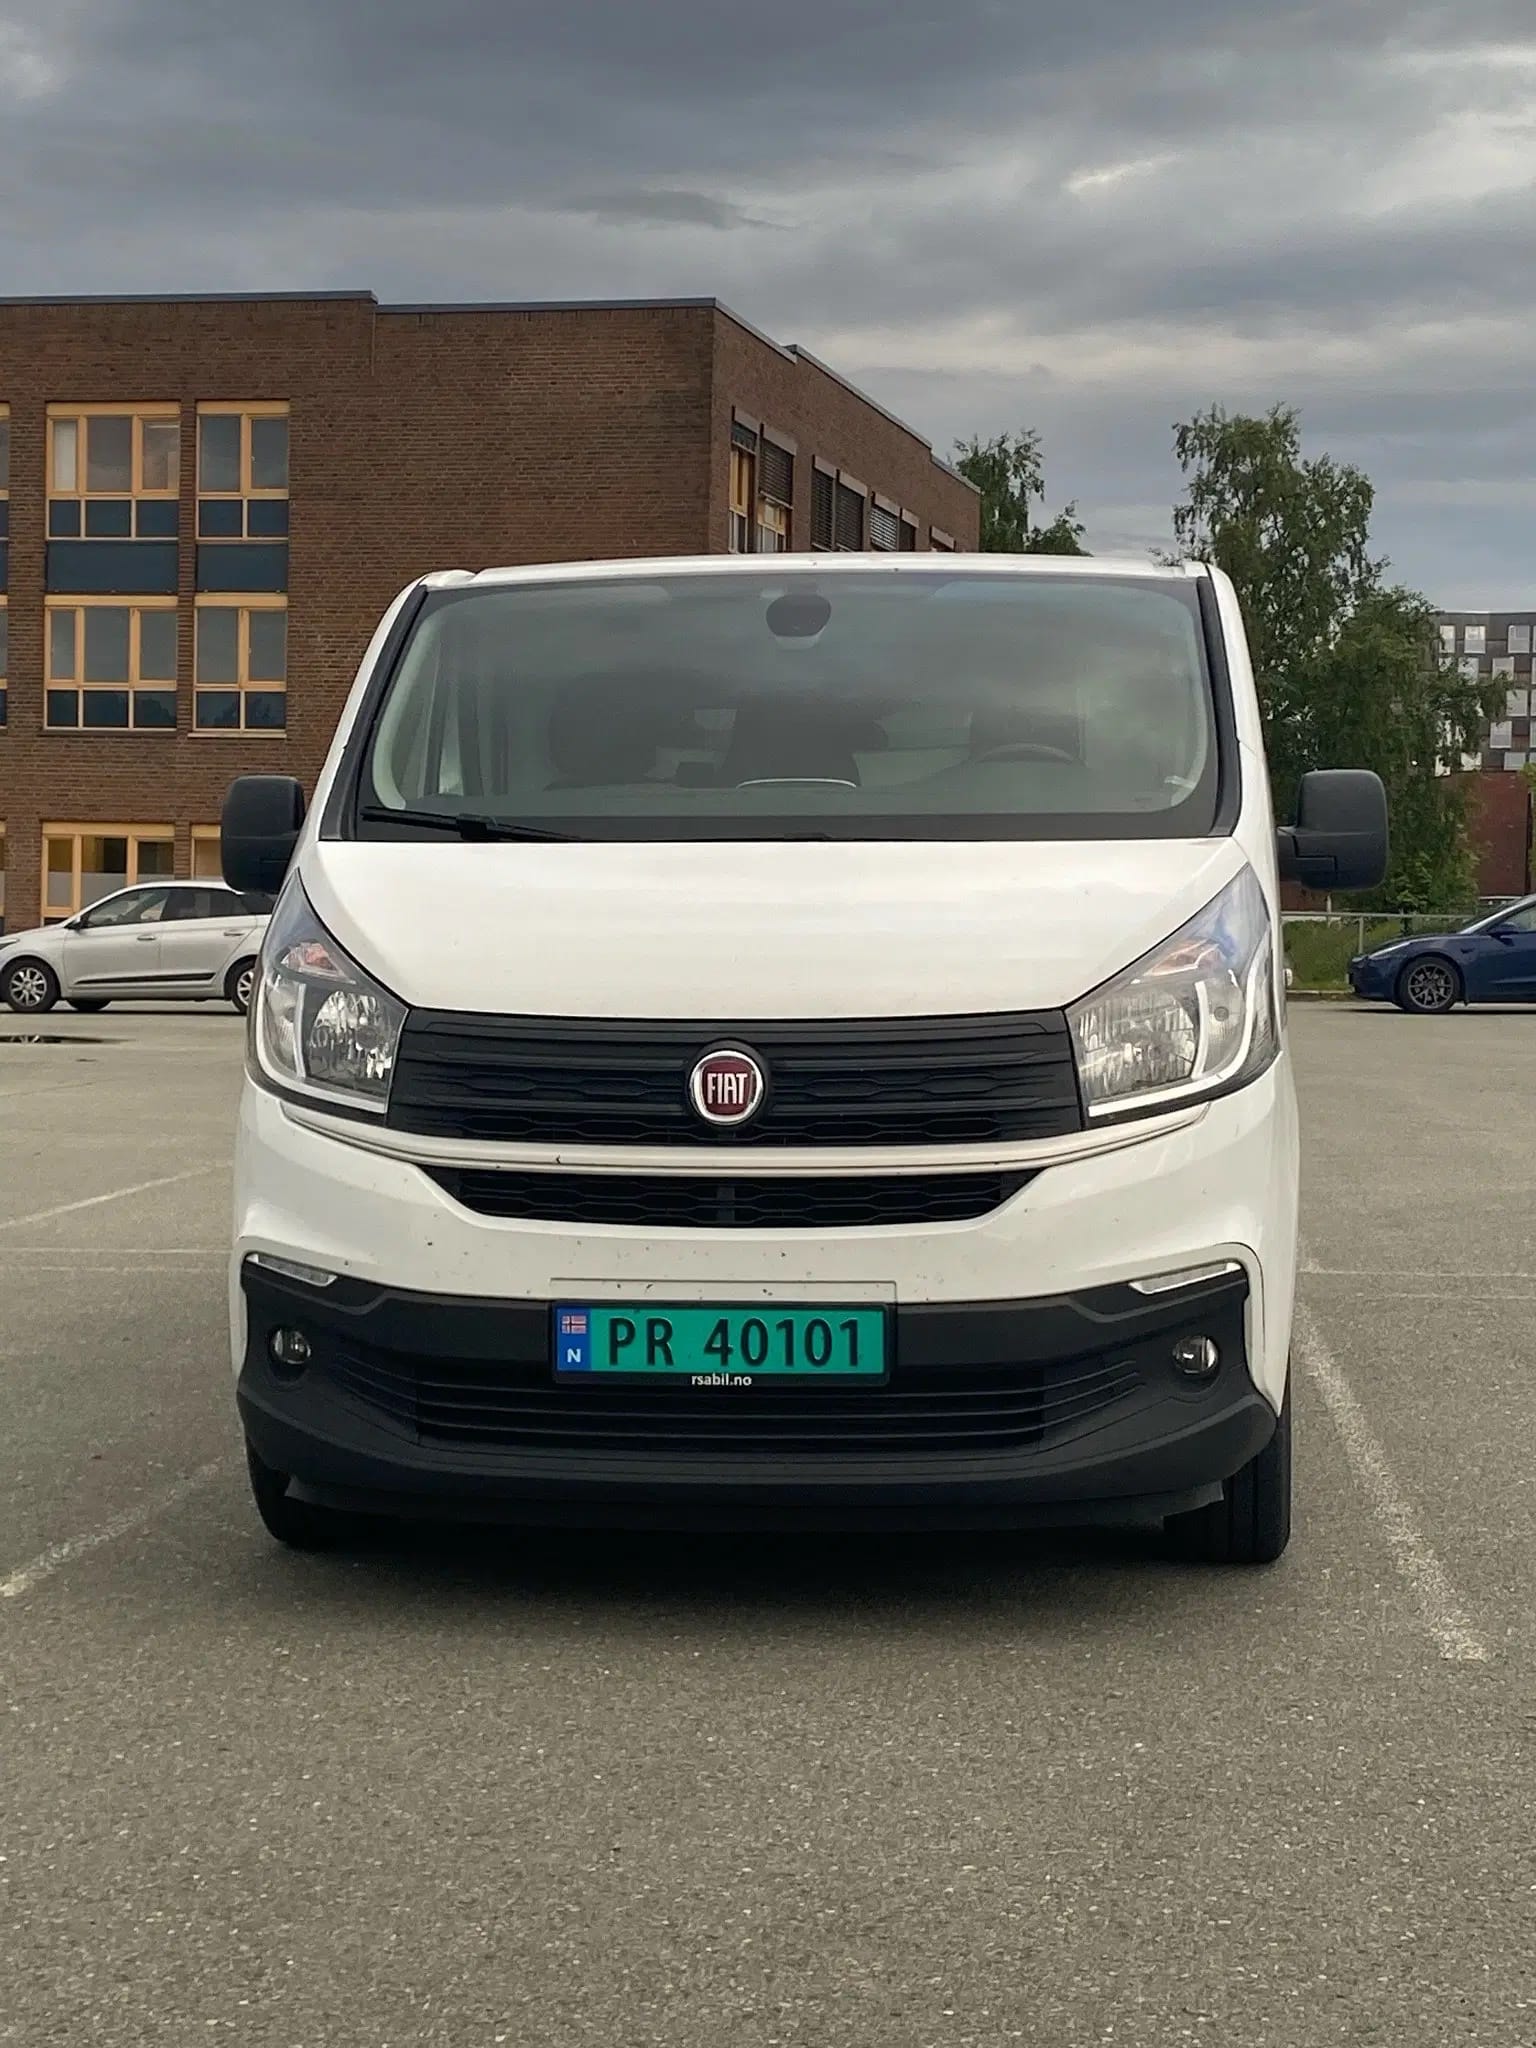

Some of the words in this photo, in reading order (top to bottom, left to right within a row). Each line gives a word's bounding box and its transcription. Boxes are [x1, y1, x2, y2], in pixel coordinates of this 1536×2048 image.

[707, 1073, 748, 1104] FIAT
[608, 1317, 675, 1366] PR
[703, 1317, 859, 1367] 40101
[567, 1348, 581, 1363] N
[691, 1373, 753, 1386] rsabil.no
